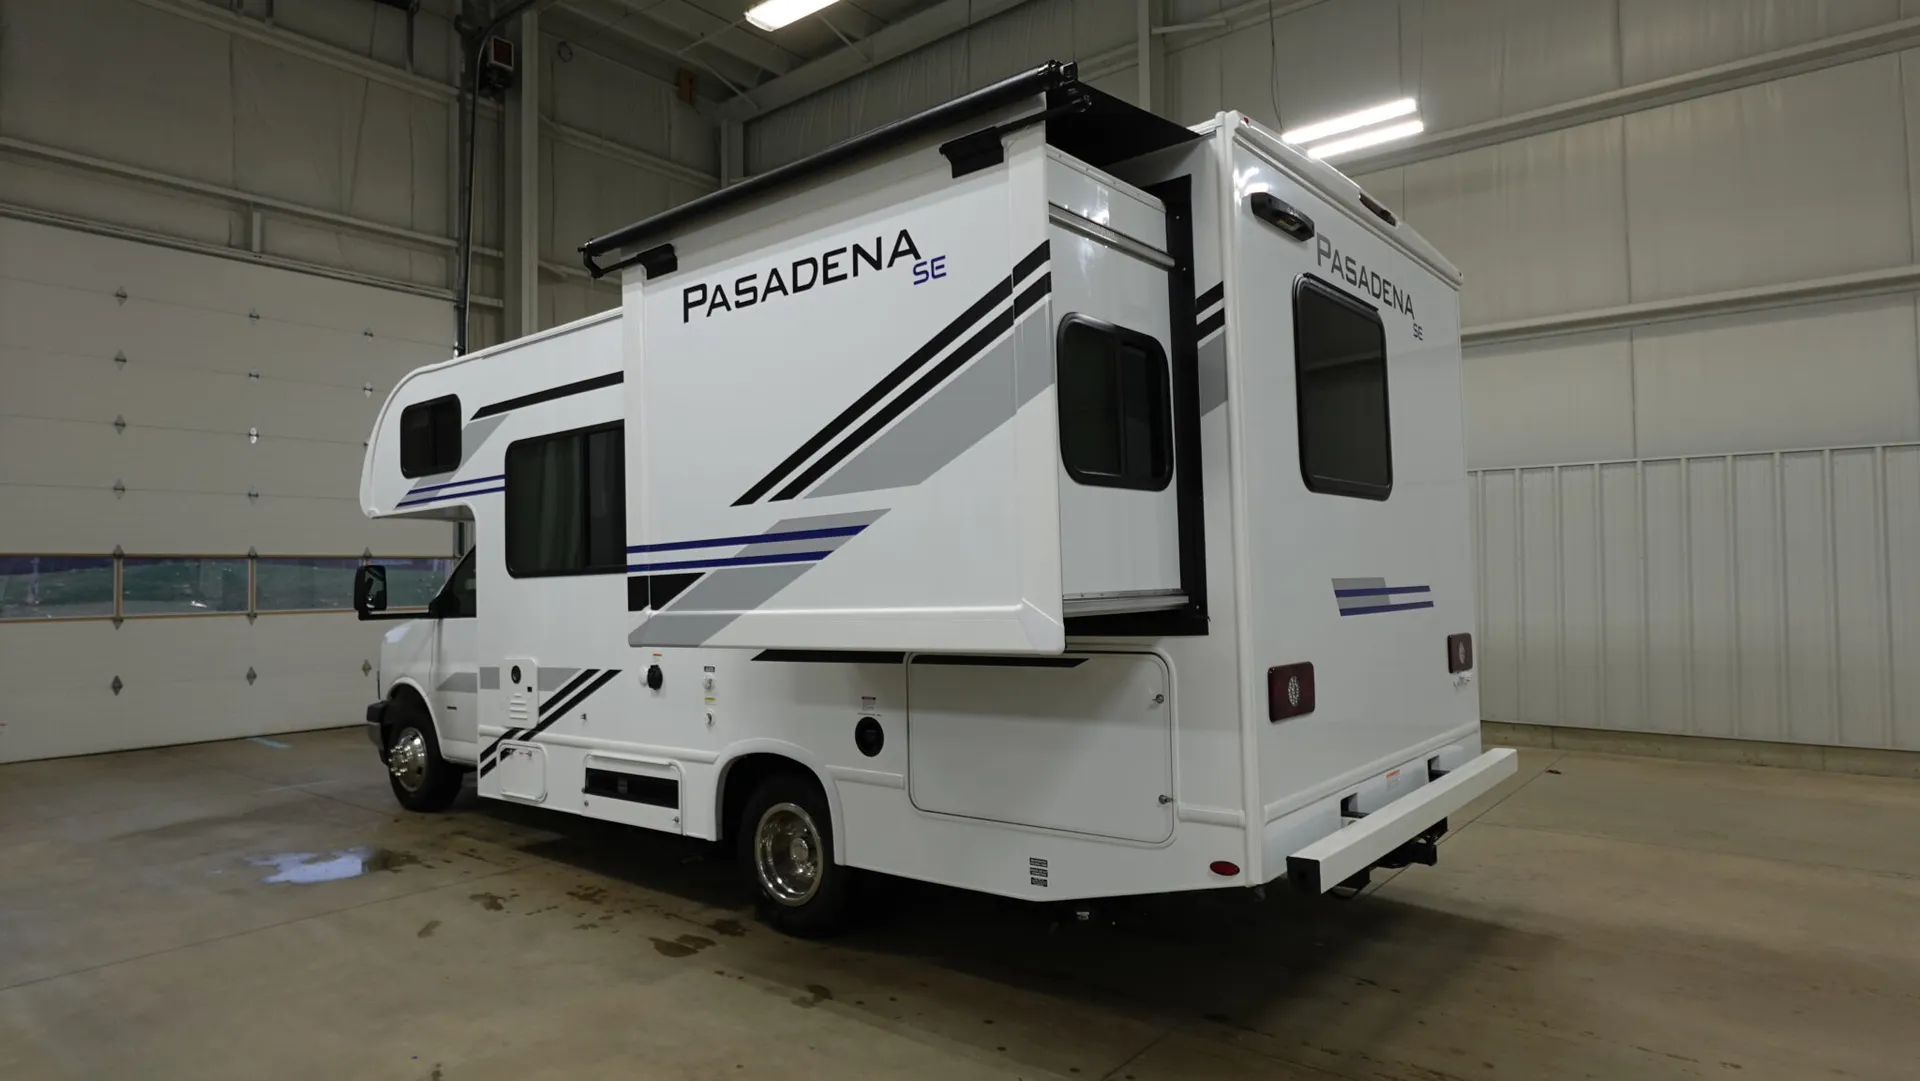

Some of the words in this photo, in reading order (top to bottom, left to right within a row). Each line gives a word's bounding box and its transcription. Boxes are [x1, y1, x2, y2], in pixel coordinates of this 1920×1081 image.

[683, 229, 921, 323] PASADENA
[913, 255, 947, 285] SE
[1316, 232, 1415, 320] PASADENA
[1413, 323, 1423, 340] SE
